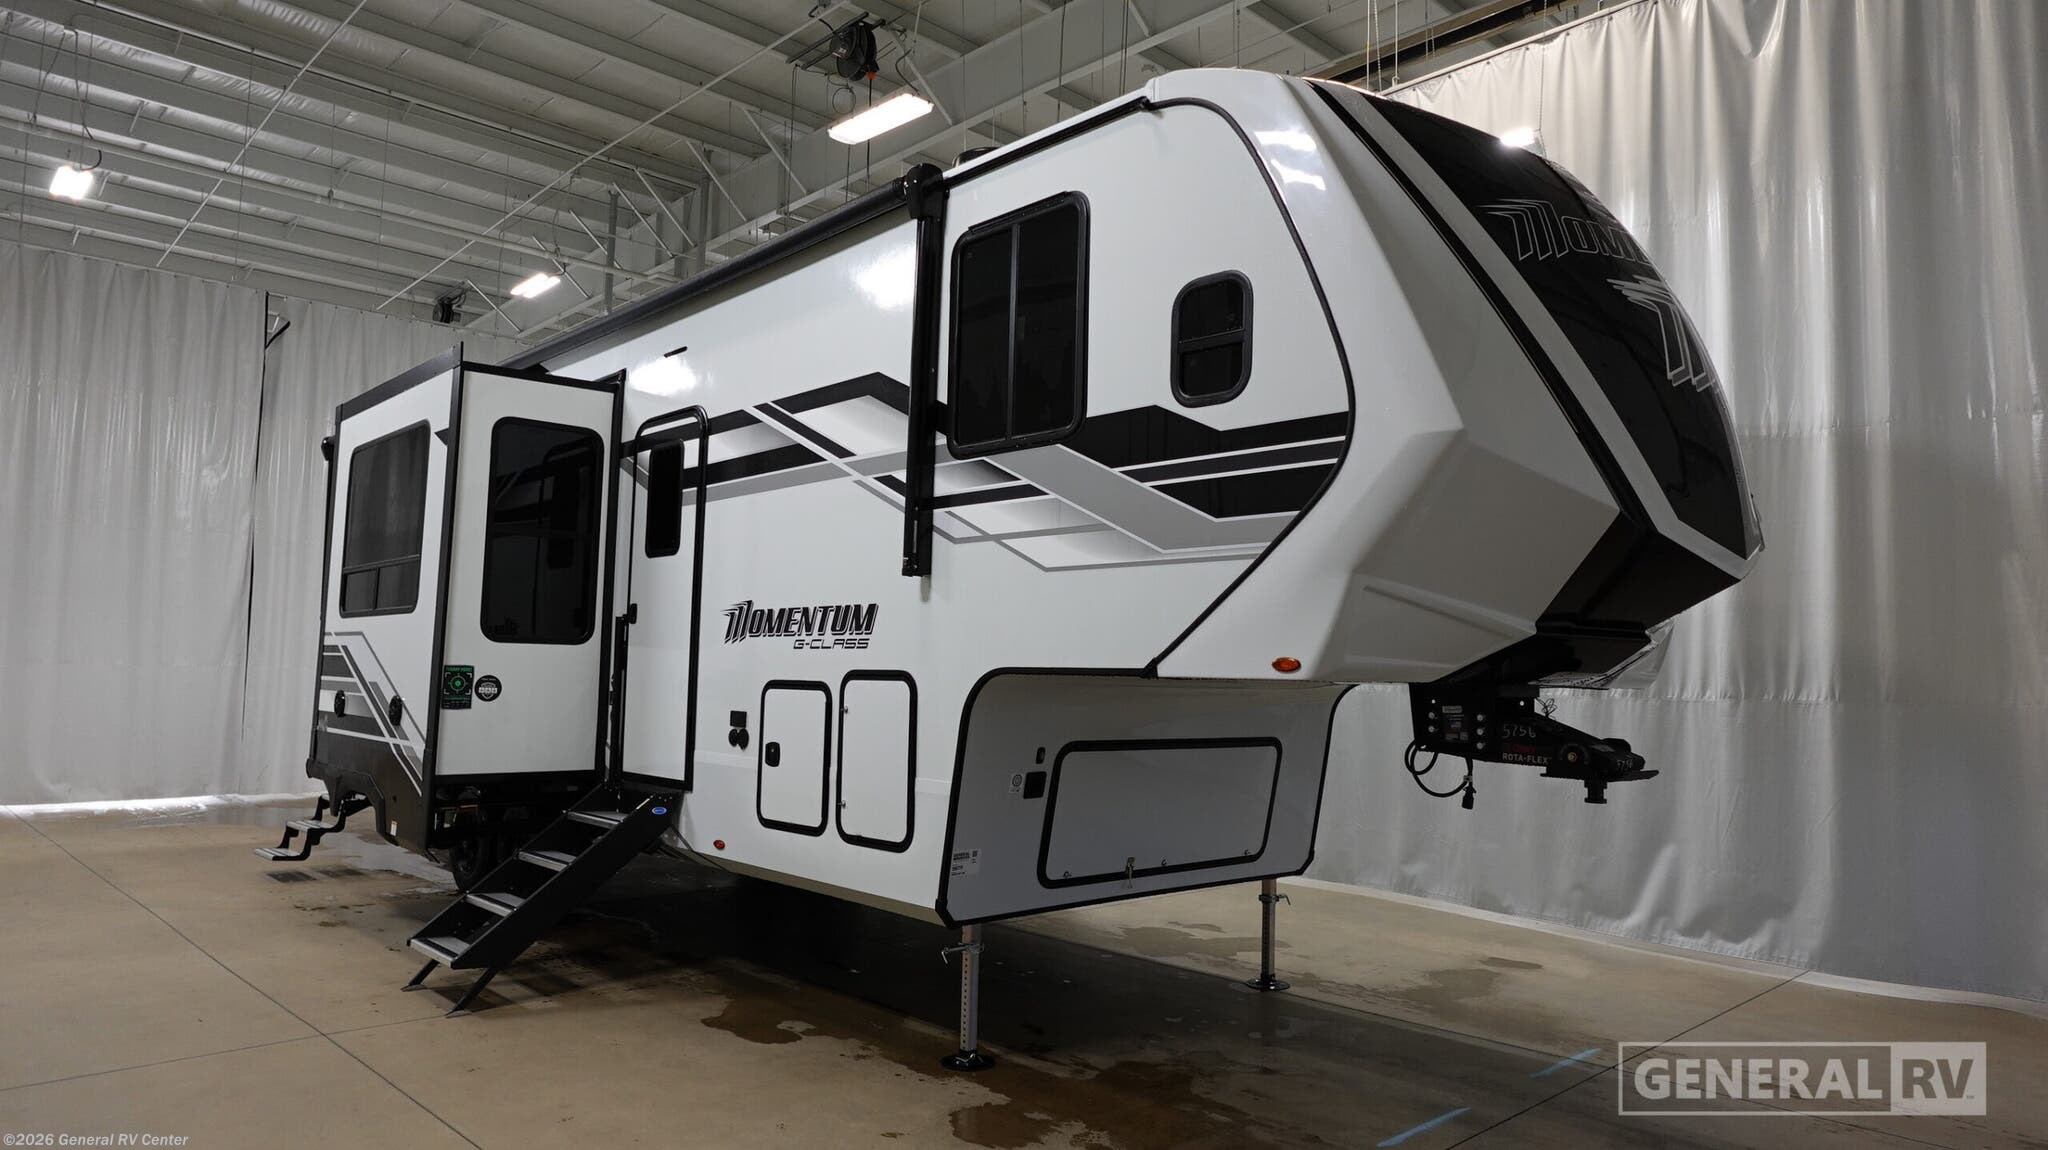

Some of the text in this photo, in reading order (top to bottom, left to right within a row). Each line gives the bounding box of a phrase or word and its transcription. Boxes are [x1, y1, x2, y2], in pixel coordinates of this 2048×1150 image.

[722, 600, 879, 644] MOMENTUM
[793, 638, 870, 650] G-CLASS
[1502, 723, 1537, 739] 5756
